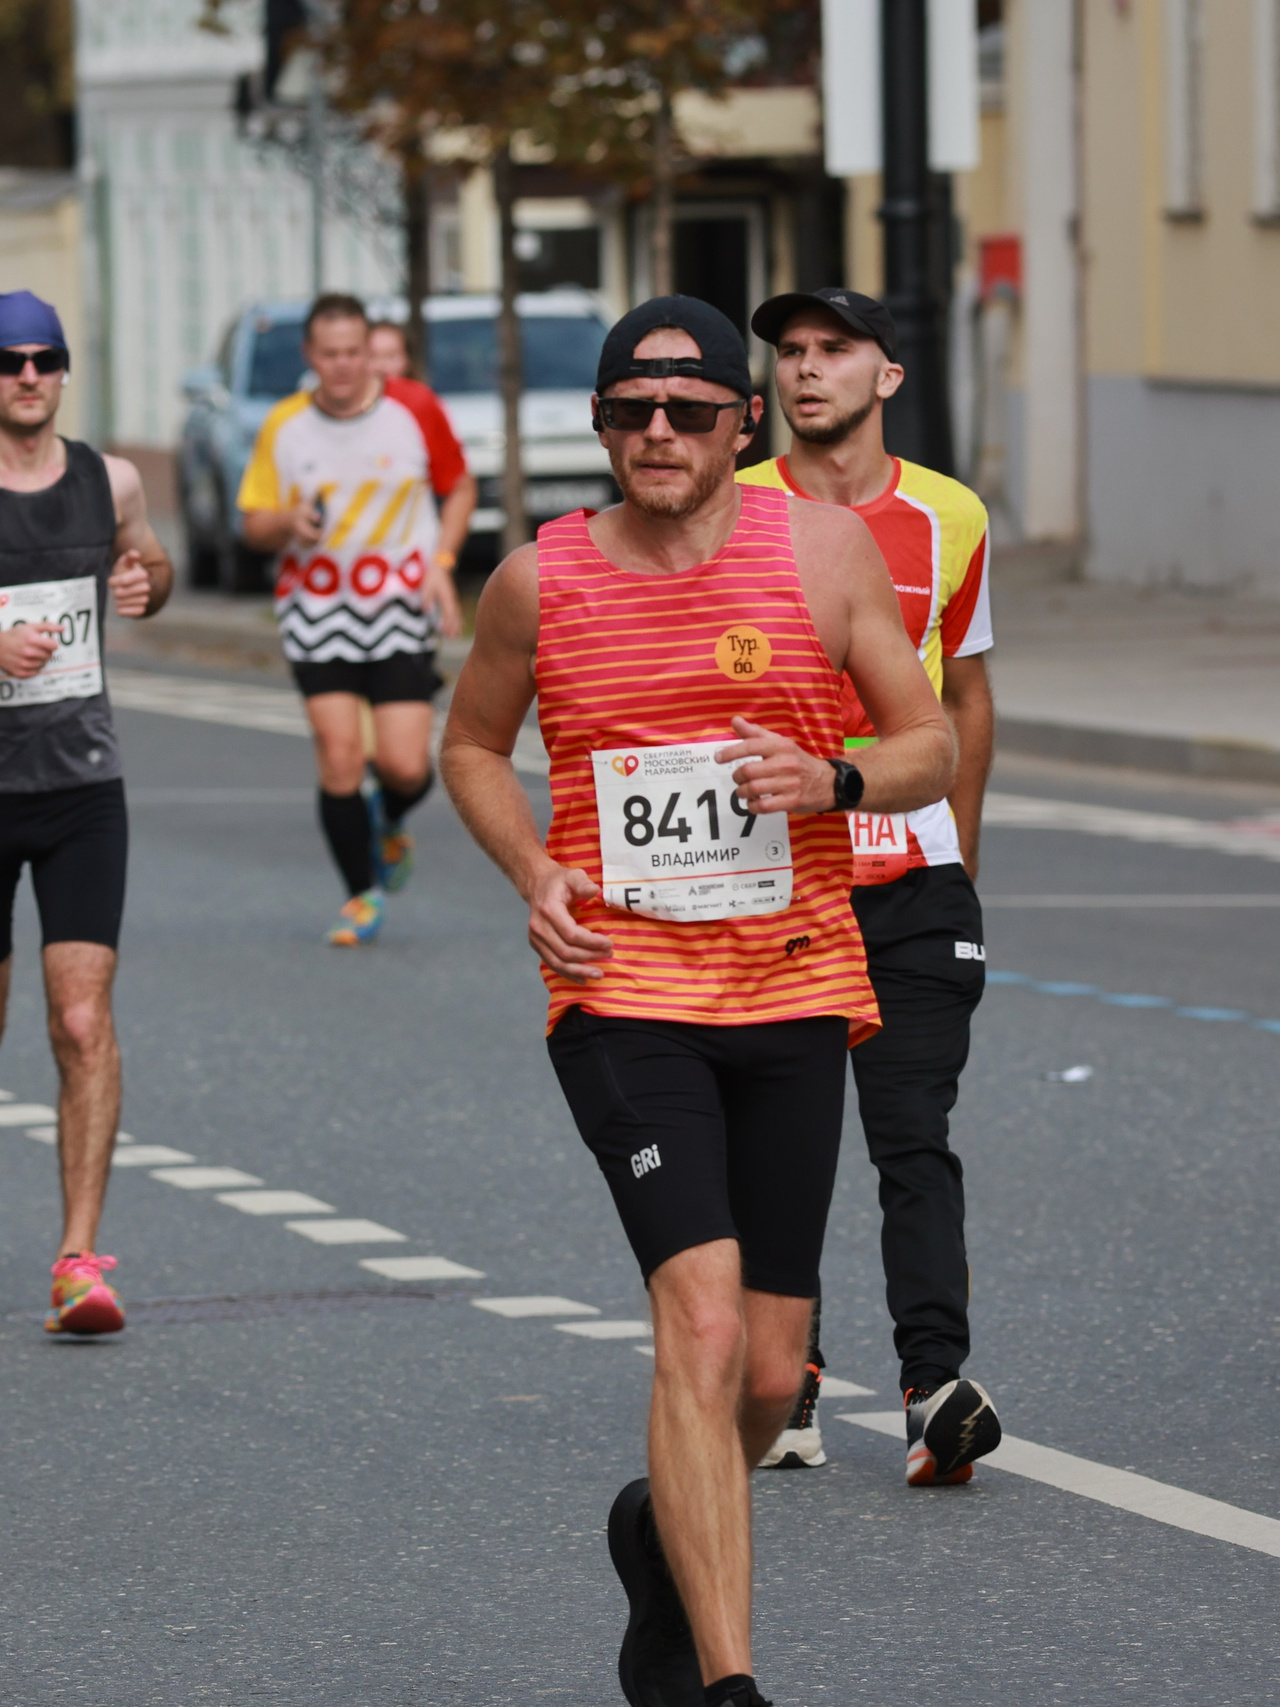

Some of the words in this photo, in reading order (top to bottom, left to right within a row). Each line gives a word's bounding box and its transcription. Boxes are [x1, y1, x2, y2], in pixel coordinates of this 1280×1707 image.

[643, 750, 692, 760] СБЕРПРАЙМ
[644, 755, 710, 768] МОСКОВСКИЙ
[645, 765, 694, 777] МАРАФОН
[623, 788, 758, 847] 8419
[651, 847, 741, 868] ВЛАДИМИР
[771, 846, 779, 856] 3
[630, 1143, 662, 1179] GRi
